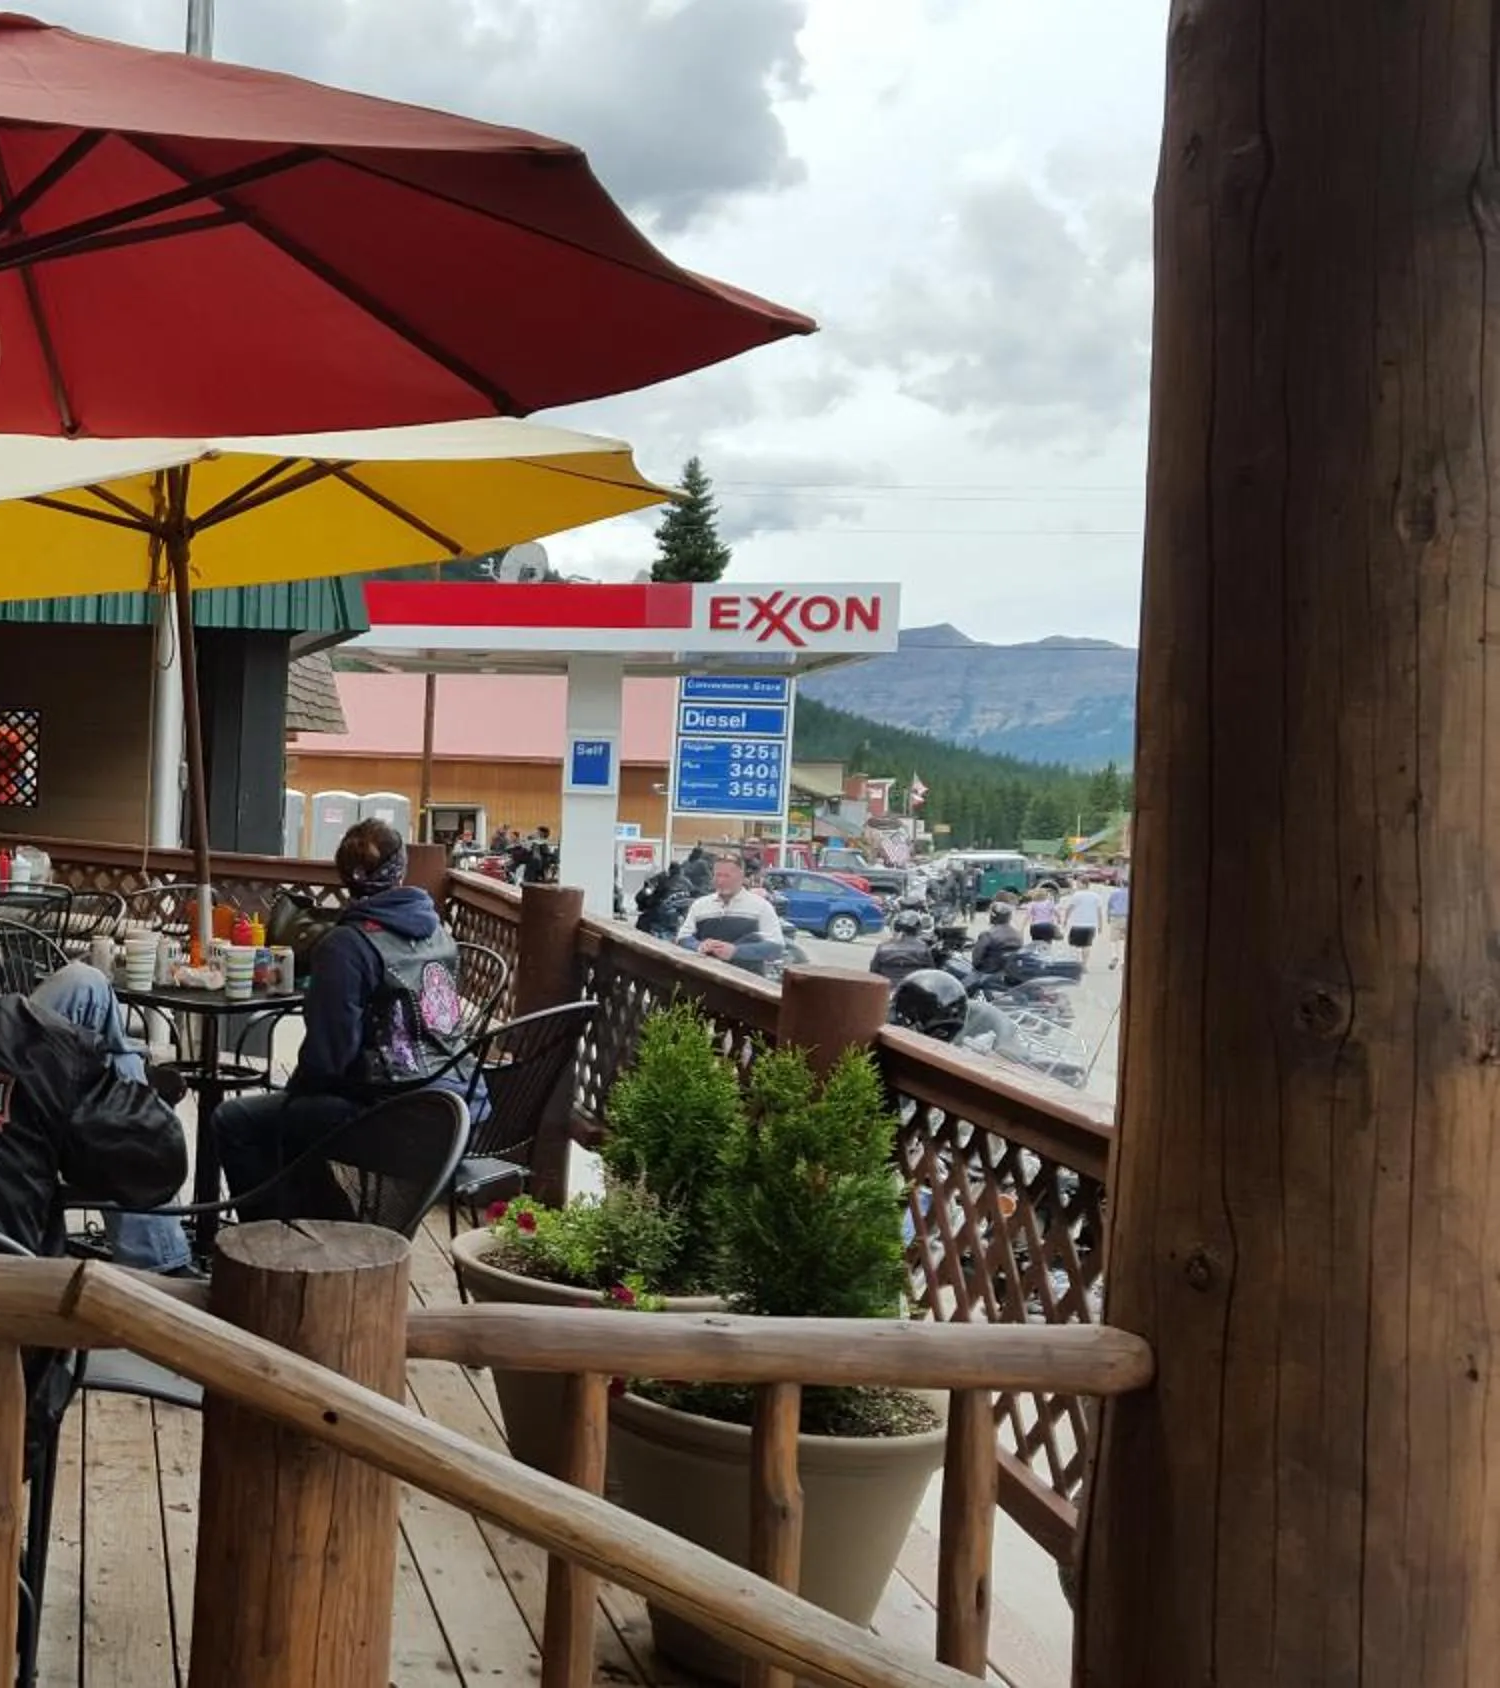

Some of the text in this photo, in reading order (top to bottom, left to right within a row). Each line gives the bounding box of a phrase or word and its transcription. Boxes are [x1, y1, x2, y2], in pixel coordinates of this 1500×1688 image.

[708, 590, 881, 647] EXXON
[685, 710, 747, 728] Diesel
[576, 743, 604, 756] Self
